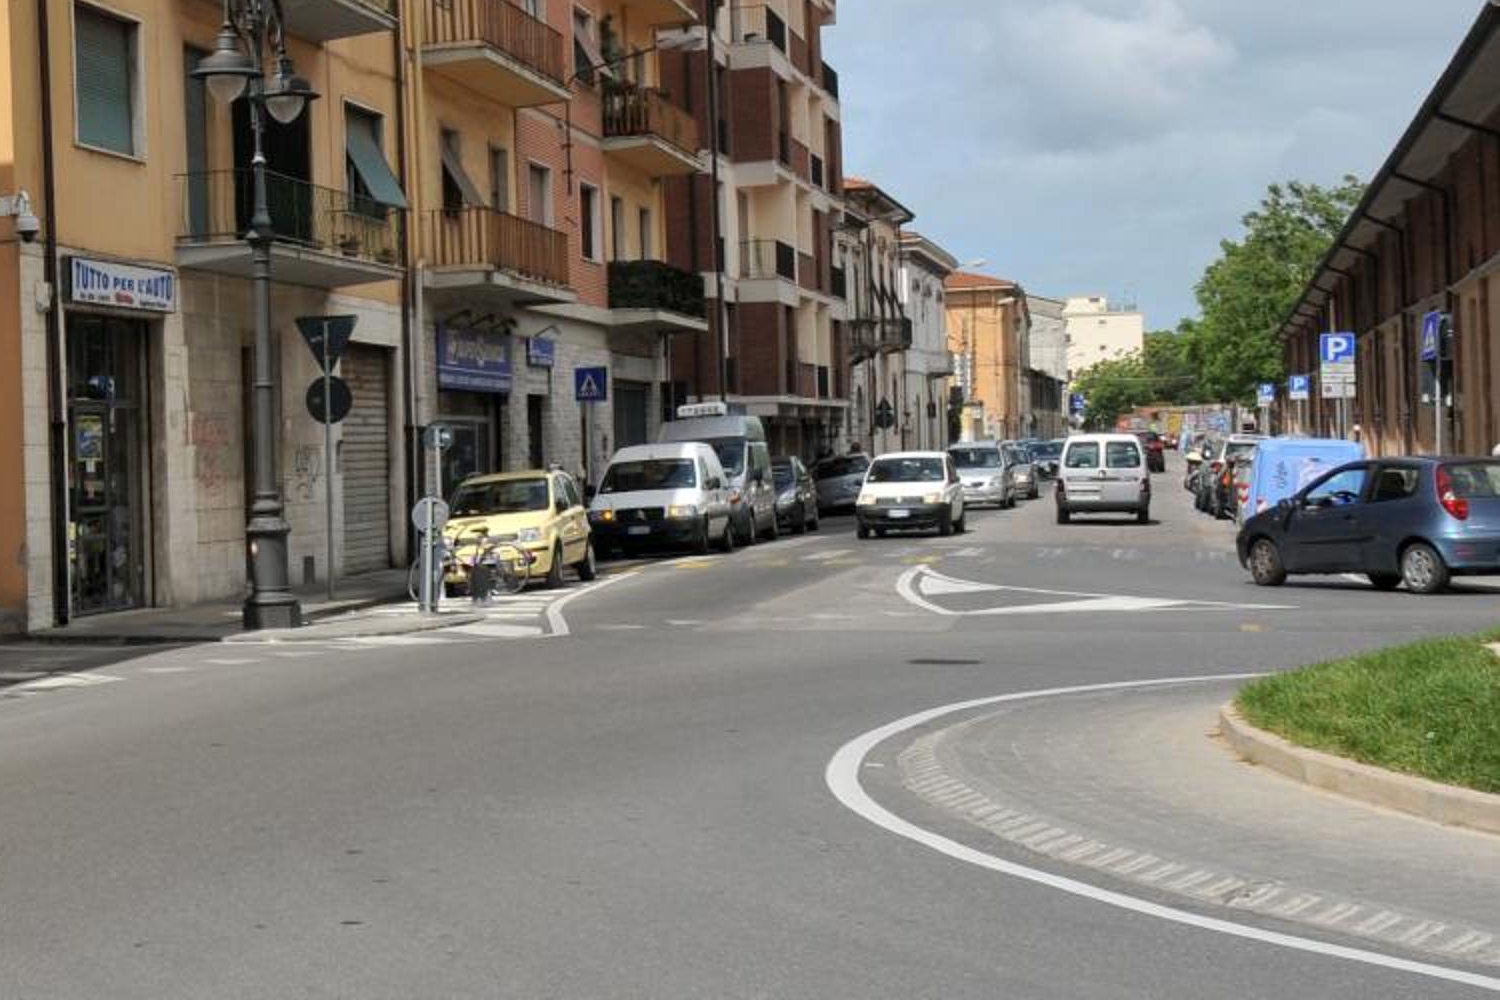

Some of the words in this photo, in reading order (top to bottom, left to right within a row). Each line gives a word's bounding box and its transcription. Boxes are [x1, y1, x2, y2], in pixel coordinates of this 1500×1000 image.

[75, 261, 109, 290] TUTTO
[113, 276, 134, 291] PER
[1327, 337, 1348, 361] P
[1293, 376, 1305, 390] P
